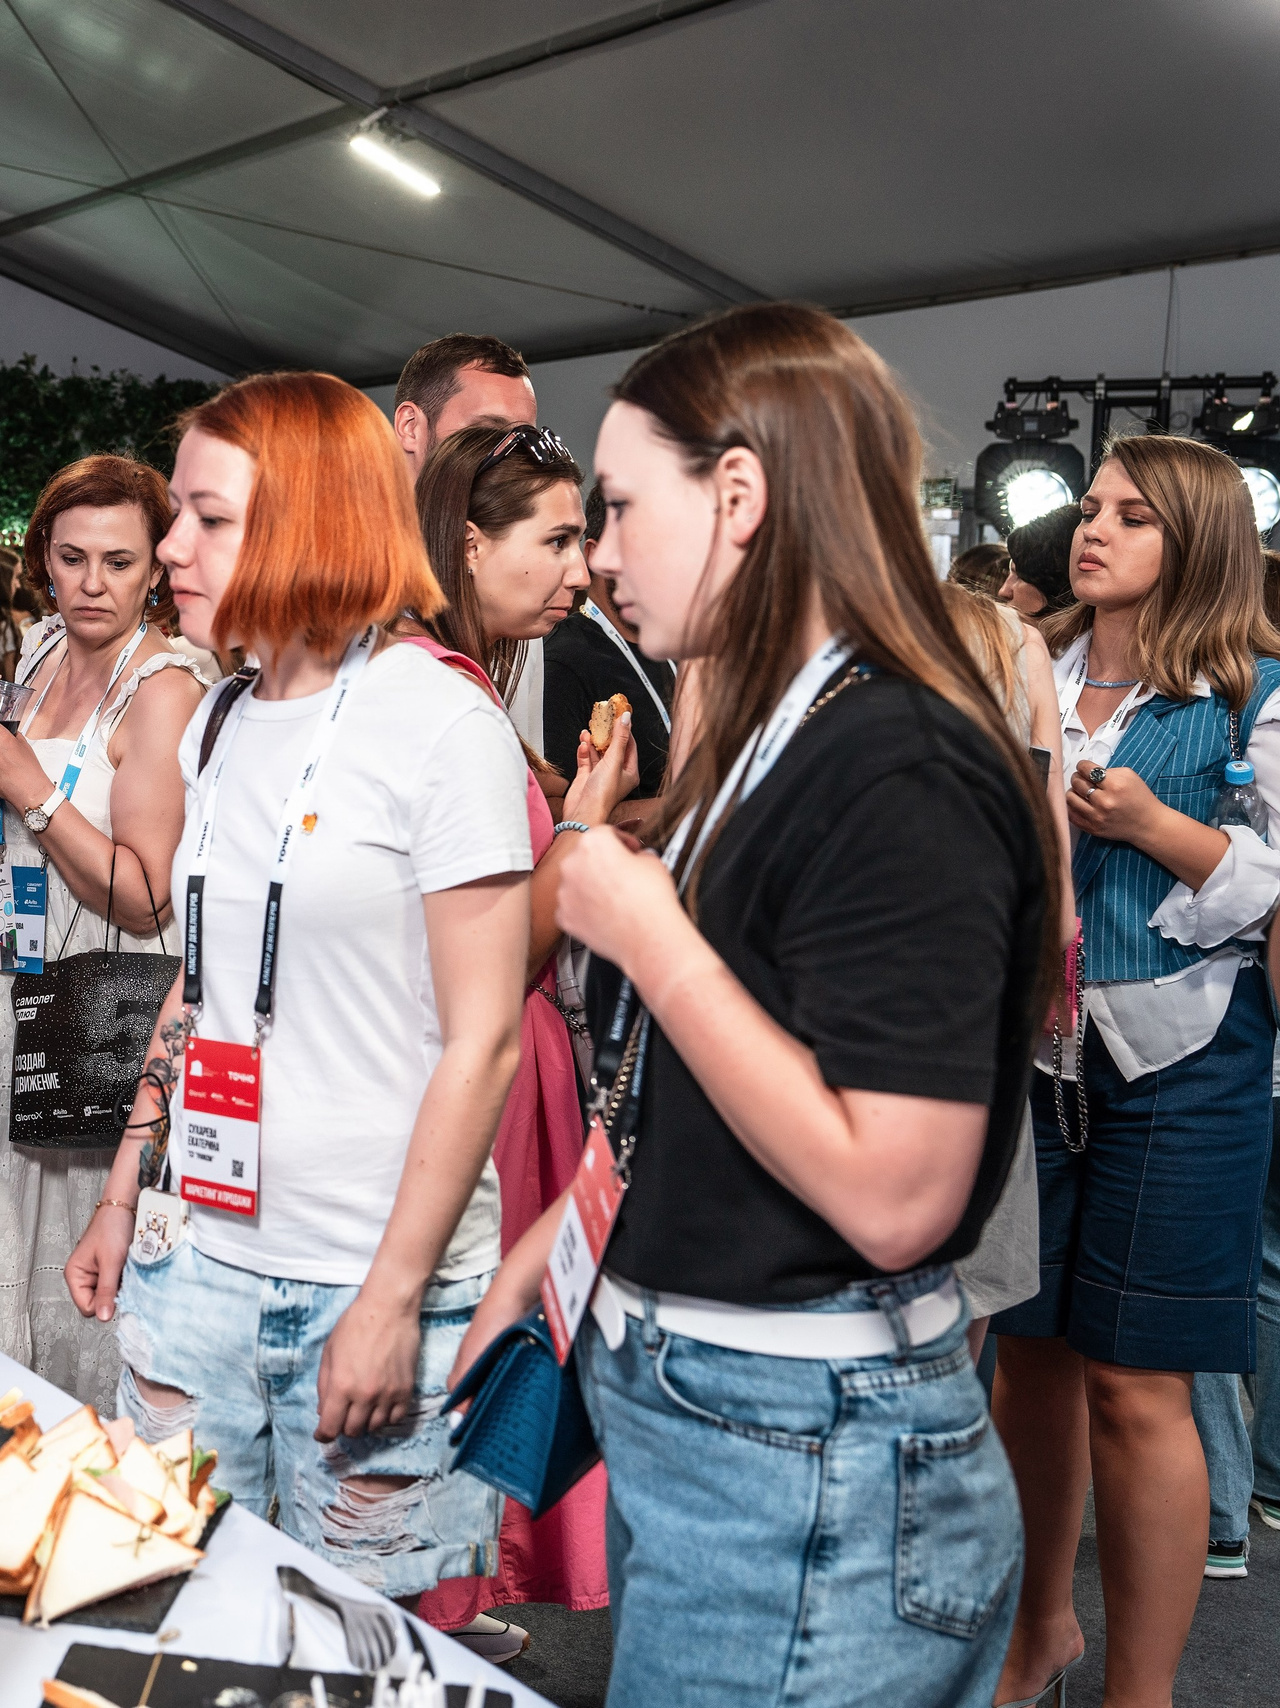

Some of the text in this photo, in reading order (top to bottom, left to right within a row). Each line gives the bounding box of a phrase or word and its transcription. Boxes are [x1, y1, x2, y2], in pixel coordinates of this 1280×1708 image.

[278, 824, 293, 864] ТОЧНО
[15, 994, 55, 1007] самолет
[15, 1051, 46, 1072] СОЗДАЮ
[15, 1072, 60, 1095] ДВИЖЕНИЕ
[15, 1111, 43, 1122] GloraX
[188, 1135, 220, 1151] ЕКАТЕРИНА
[185, 1182, 216, 1201] МАРКЕТИНГ
